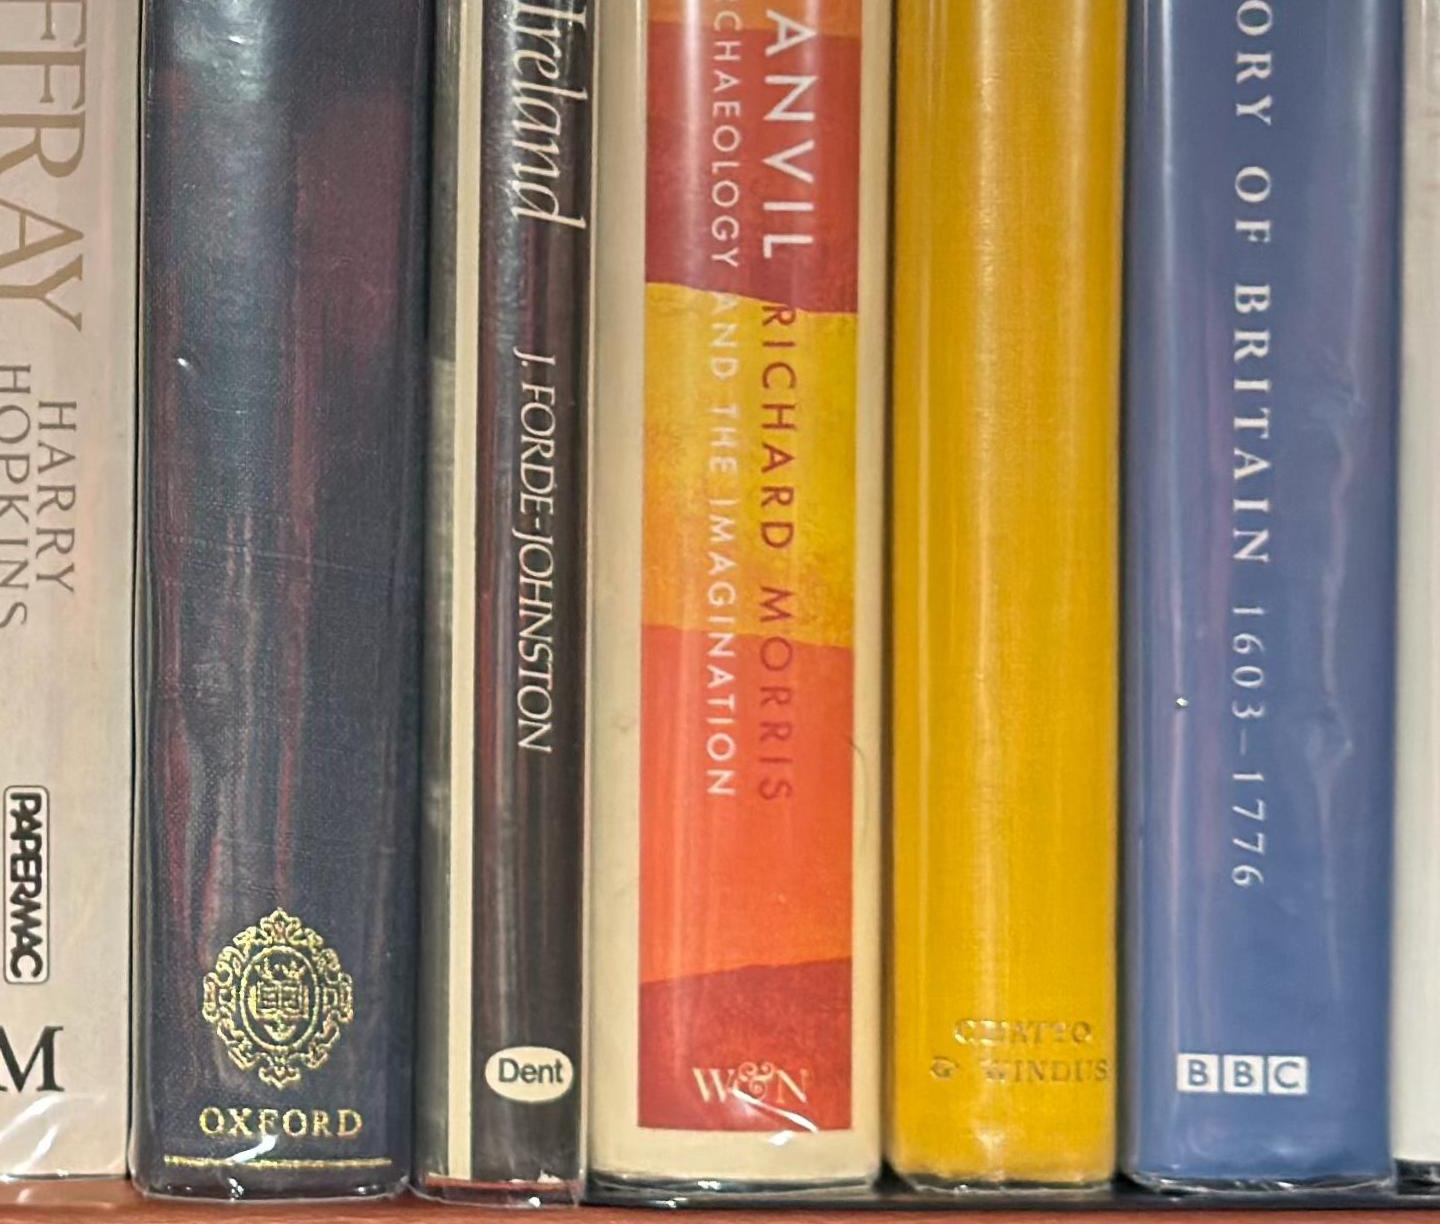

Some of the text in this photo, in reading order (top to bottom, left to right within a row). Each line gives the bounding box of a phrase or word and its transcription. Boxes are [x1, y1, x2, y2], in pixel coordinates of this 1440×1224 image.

[761, 9, 819, 260] ANVIL
[1234, 166, 1272, 244] OF
[513, 346, 556, 368] J.
[709, 291, 740, 381] AND
[761, 304, 797, 551] RICHARD
[1231, 282, 1271, 564] BRITAIN
[35, 400, 78, 594] HARRY
[708, 404, 739, 474] THE
[512, 380, 556, 754] FORDE-JOHNSTON
[706, 499, 738, 797] IMAGINATION
[758, 585, 795, 802] MORRIS
[9, 791, 45, 980] PAPERMAC
[198, 1106, 363, 1137] OXFORD
[497, 1057, 565, 1085] Dent
[1186, 1058, 1302, 1090] BBC
